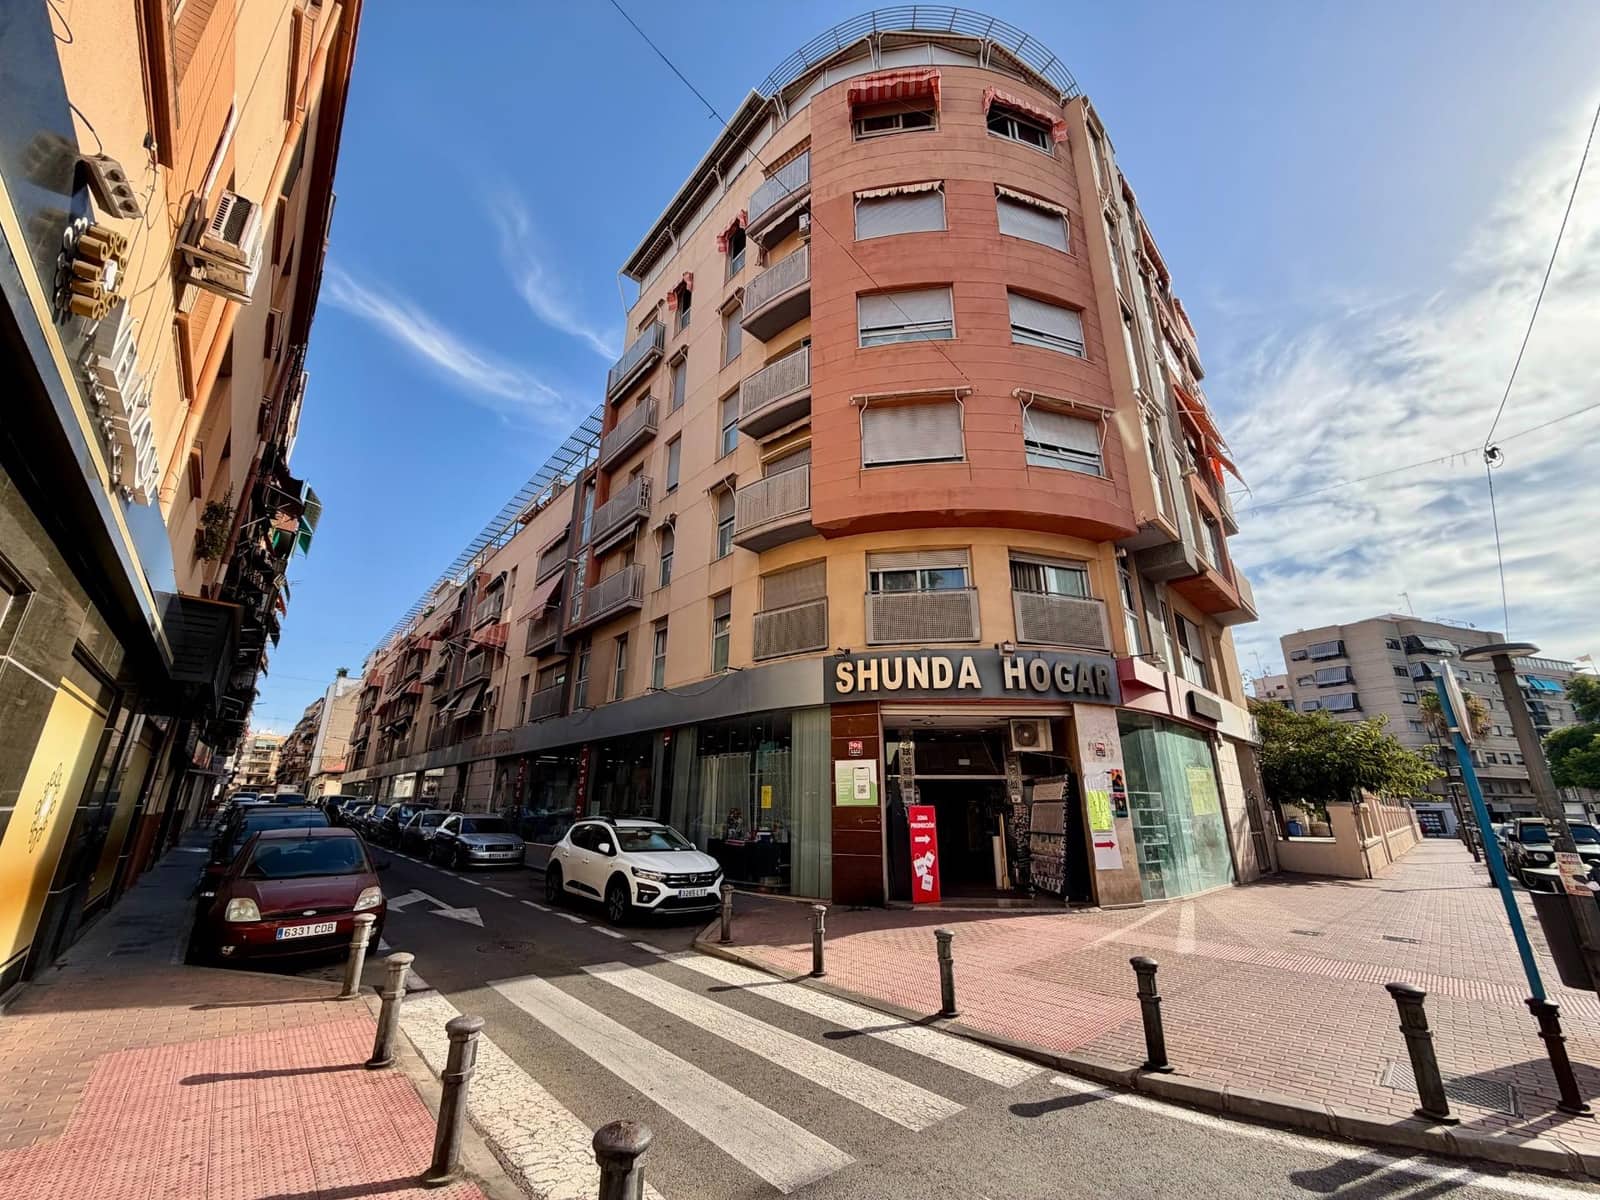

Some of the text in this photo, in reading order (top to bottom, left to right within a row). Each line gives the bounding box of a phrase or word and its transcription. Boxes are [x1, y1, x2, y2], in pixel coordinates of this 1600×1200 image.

[835, 656, 1111, 695] SHUNDA HOGAR
[284, 926, 310, 937] 6331
